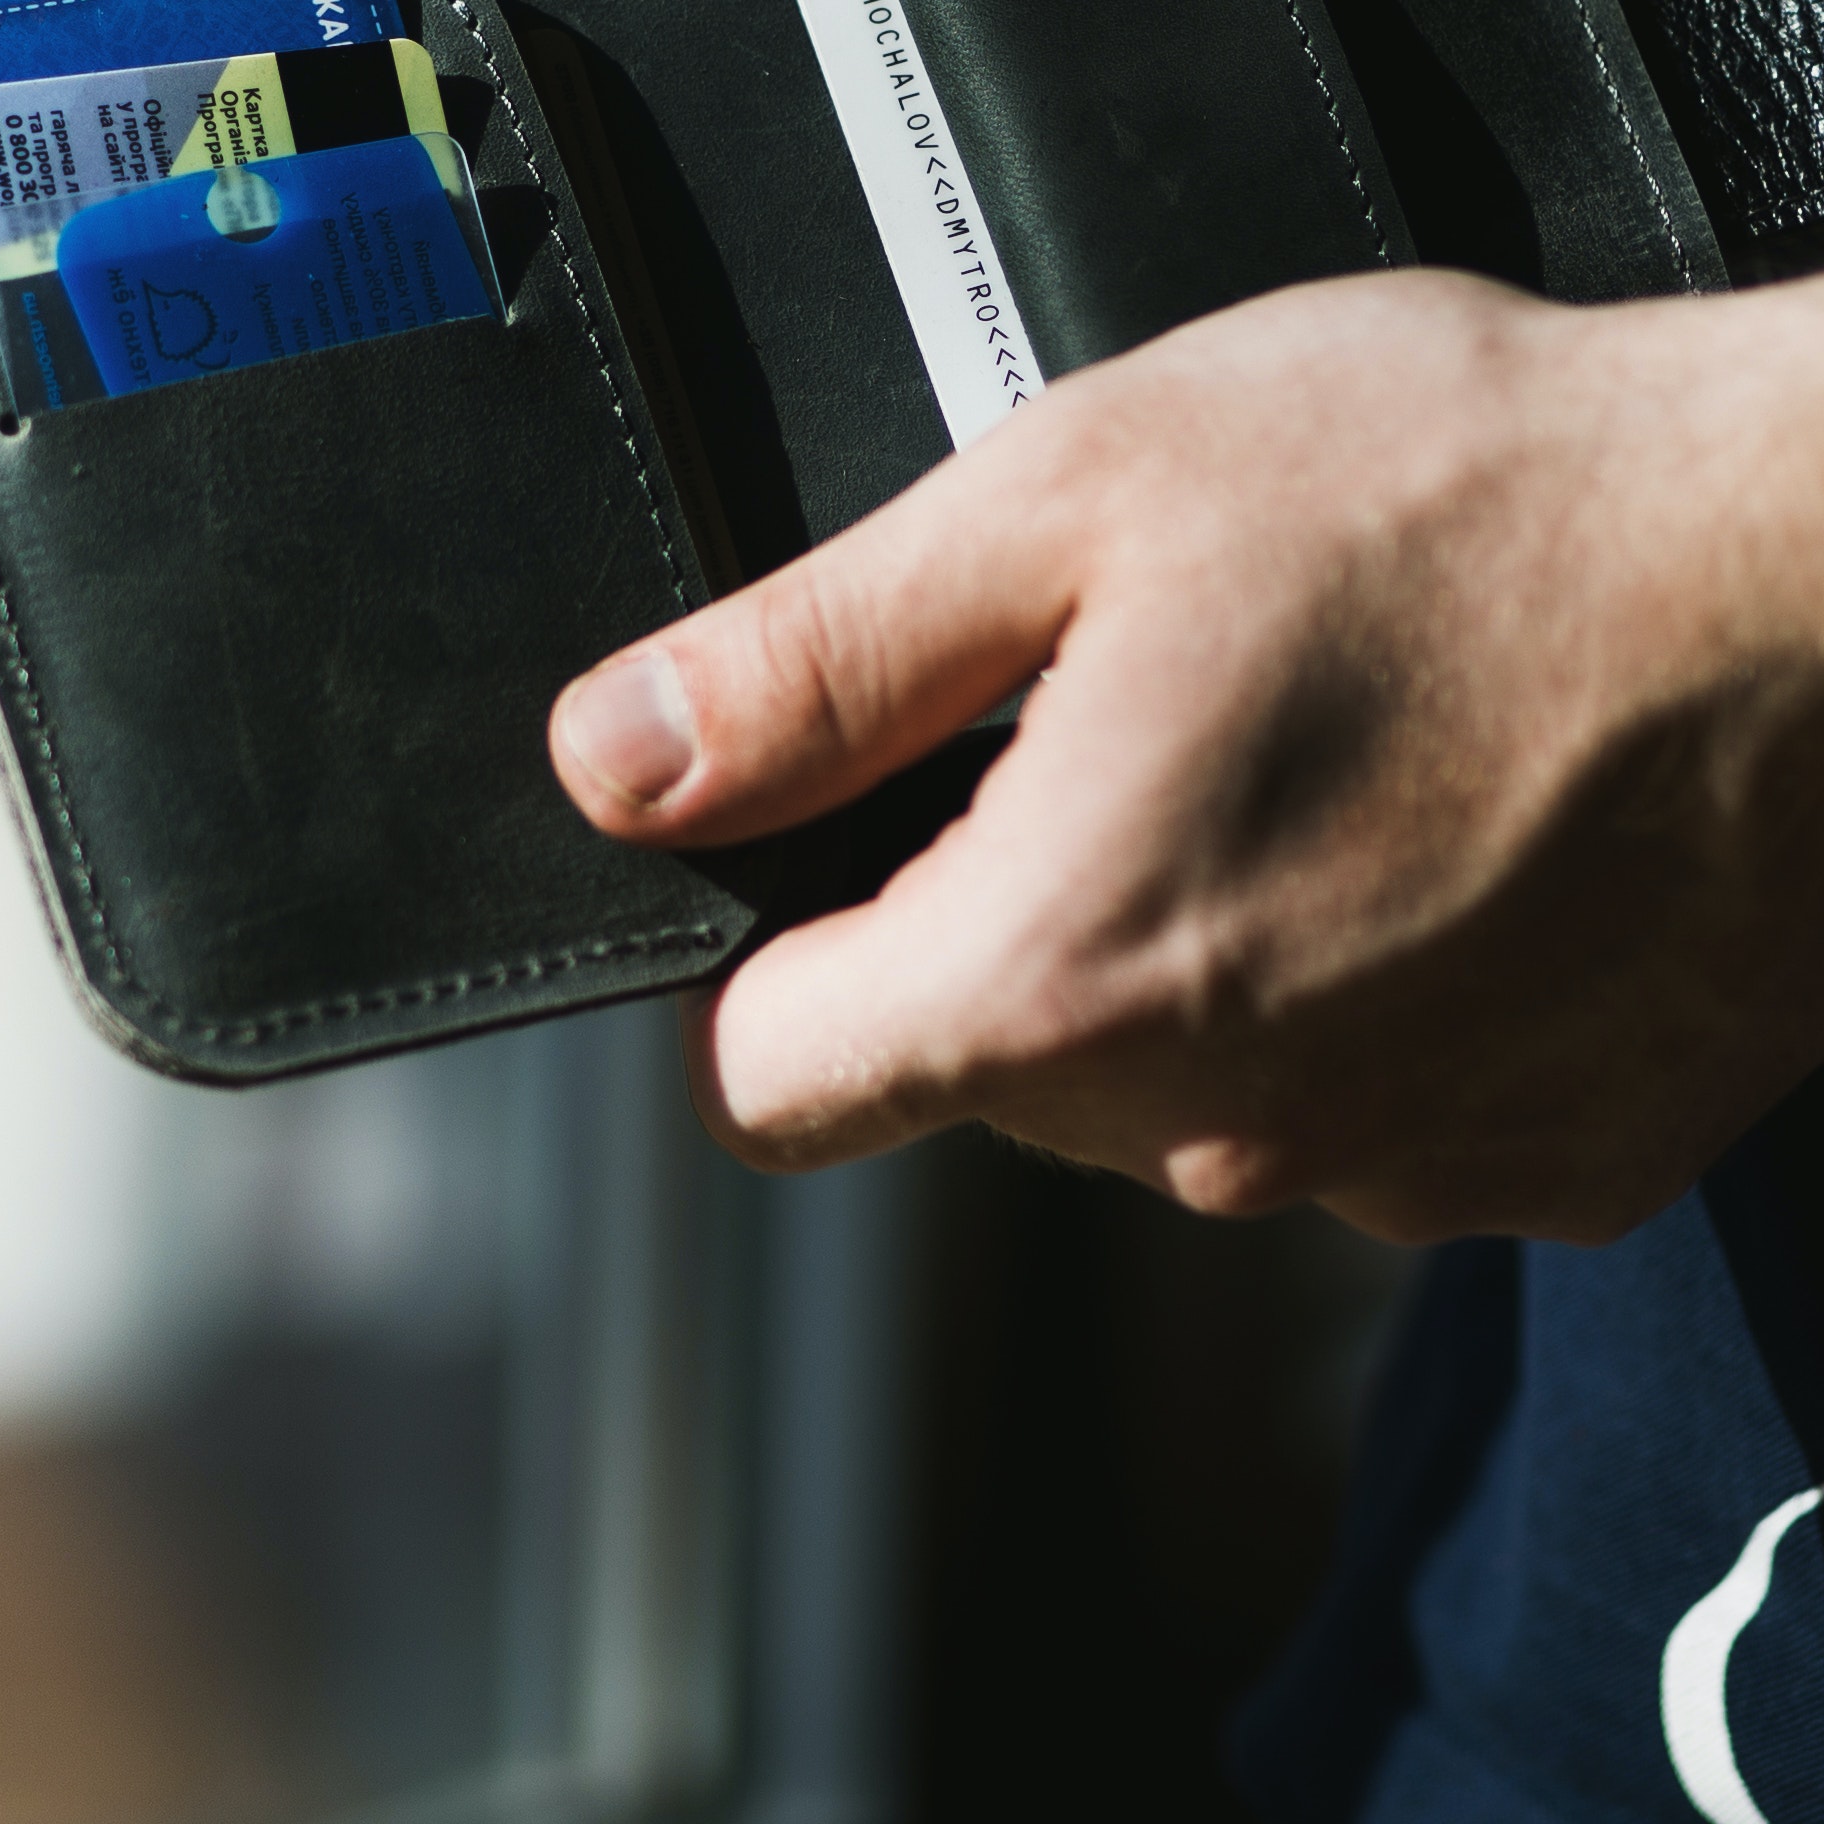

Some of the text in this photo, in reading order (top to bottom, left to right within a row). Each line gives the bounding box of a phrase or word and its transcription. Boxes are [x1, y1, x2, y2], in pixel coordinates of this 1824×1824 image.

[5, 114, 23, 129] 0
[9, 133, 33, 175] 800
[28, 111, 57, 196] та прогр
[50, 110, 76, 176] гаряча
[97, 104, 130, 183] на сайті
[116, 101, 150, 183] у програ
[144, 98, 172, 180] Офіційн
[197, 92, 225, 169] Програ
[220, 90, 251, 165] Організ
[243, 87, 269, 158] Картка
